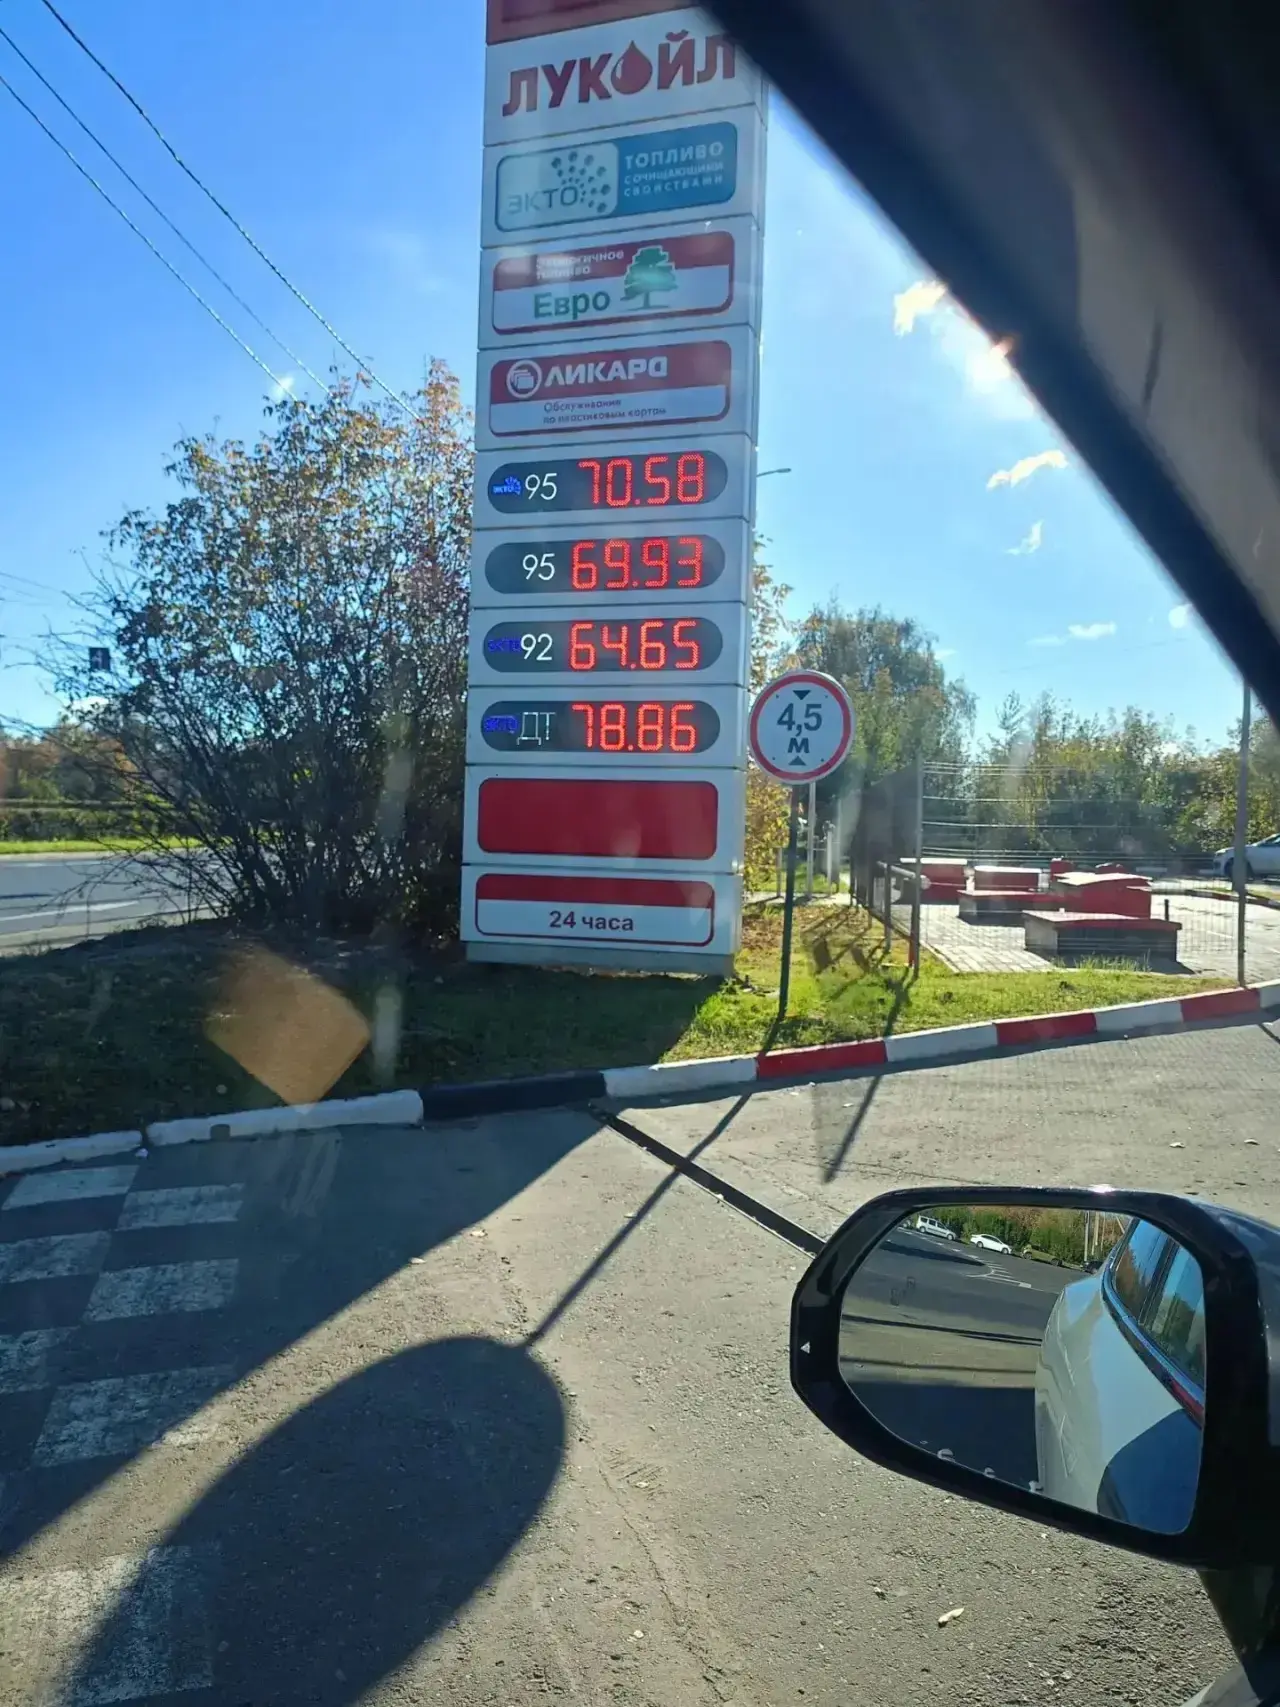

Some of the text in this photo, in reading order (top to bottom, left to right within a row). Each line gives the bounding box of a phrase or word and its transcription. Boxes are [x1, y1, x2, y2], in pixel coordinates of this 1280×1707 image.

[502, 29, 736, 117] ЛУКОЙЛ
[624, 141, 724, 170] ТОПЛИВО
[533, 290, 611, 320] Евро
[525, 472, 558, 500] 95
[578, 453, 705, 507] 70.58
[522, 536, 703, 590] 95 69.93
[520, 633, 553, 661] 92
[570, 620, 699, 670] 64.65
[516, 711, 556, 746] ДТ
[571, 702, 697, 751] 78.86
[776, 703, 823, 737] 4,5
[549, 910, 634, 931] 24 часа
